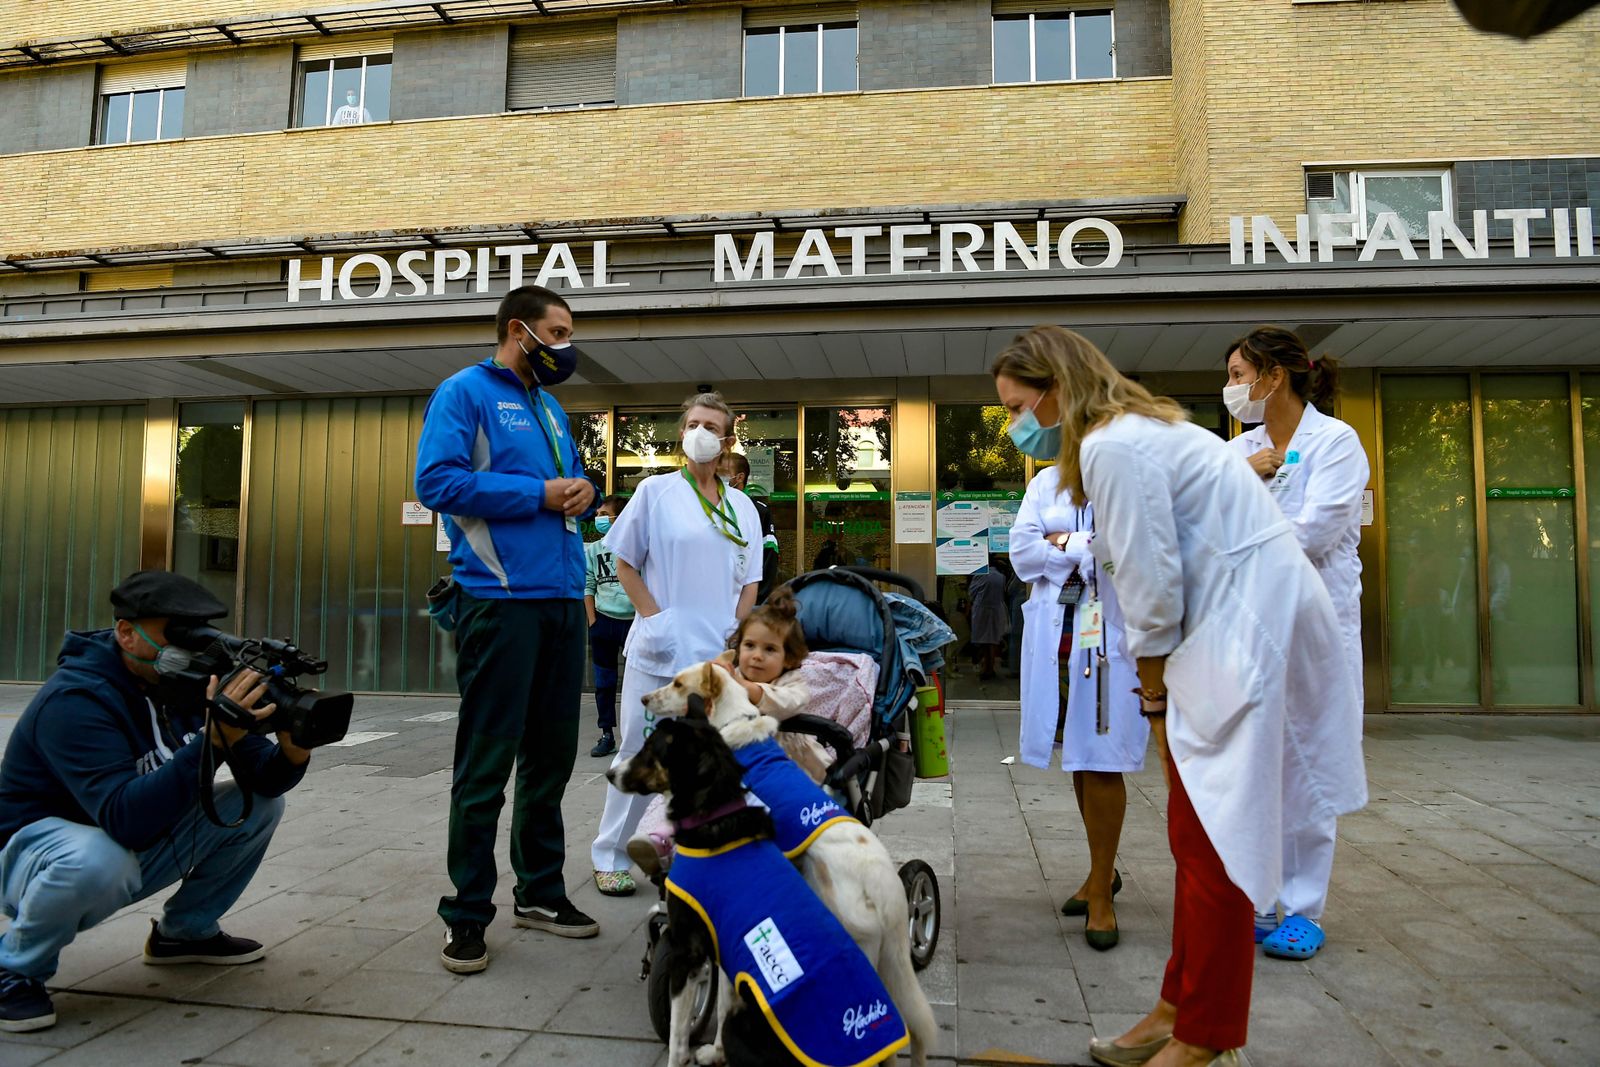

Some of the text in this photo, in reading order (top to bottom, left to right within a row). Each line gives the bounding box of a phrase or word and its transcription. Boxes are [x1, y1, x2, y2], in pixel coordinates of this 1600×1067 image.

[287, 240, 631, 302] HOSPITAL
[714, 217, 1123, 282] MATERNO
[760, 943, 789, 984] aecc
